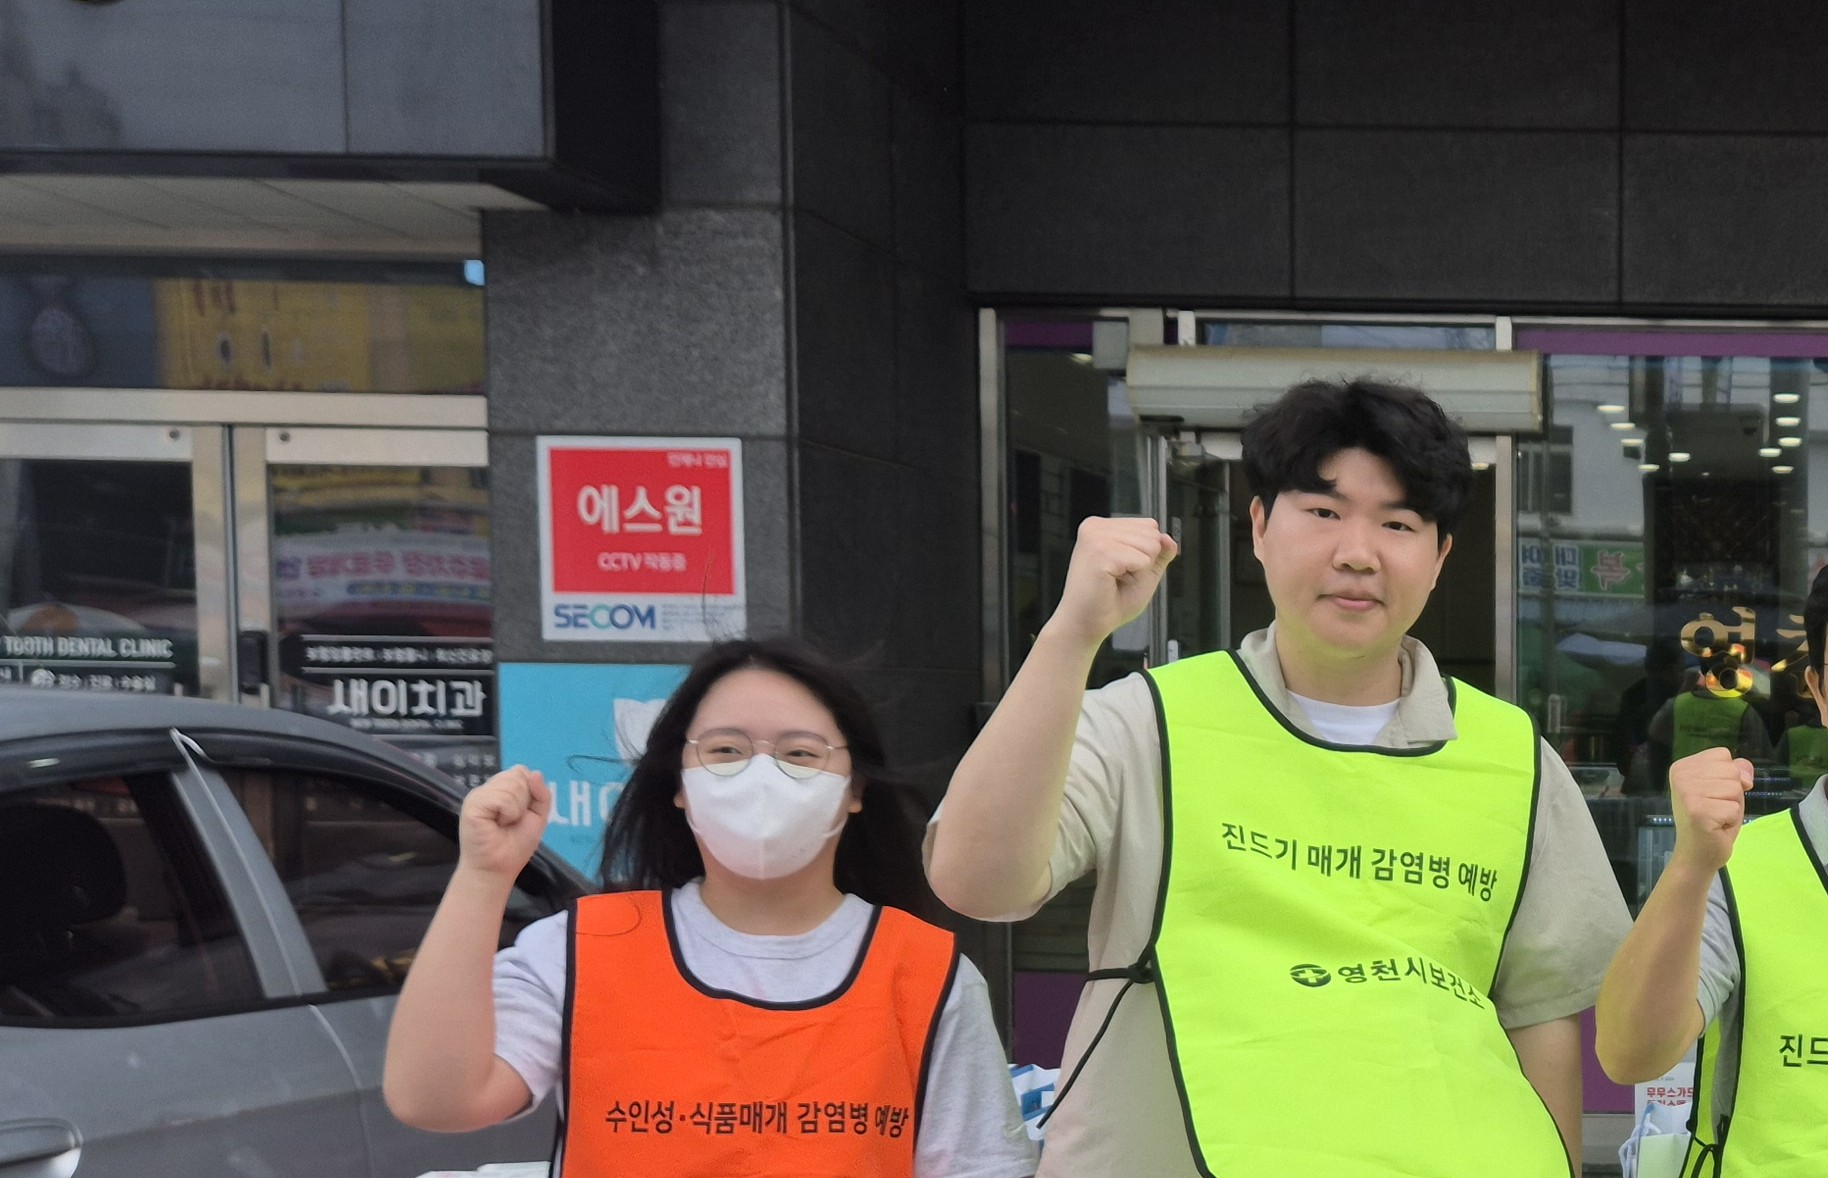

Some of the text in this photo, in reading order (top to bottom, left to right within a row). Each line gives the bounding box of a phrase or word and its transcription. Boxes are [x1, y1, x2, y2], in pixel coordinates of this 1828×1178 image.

[577, 484, 702, 535] 에스원
[598, 553, 642, 571] CCTV
[554, 604, 656, 629] SECOM
[57, 636, 117, 658] DENTAL
[118, 638, 173, 658] CLINIC
[327, 679, 487, 717] 새이치과
[548, 780, 623, 827] 새
[1222, 822, 1498, 901] 진드기 매개 감염병 예방
[1338, 957, 1485, 1009] 영천시보건소
[606, 1101, 909, 1138] 수인성·식품매개 감염병 예방
